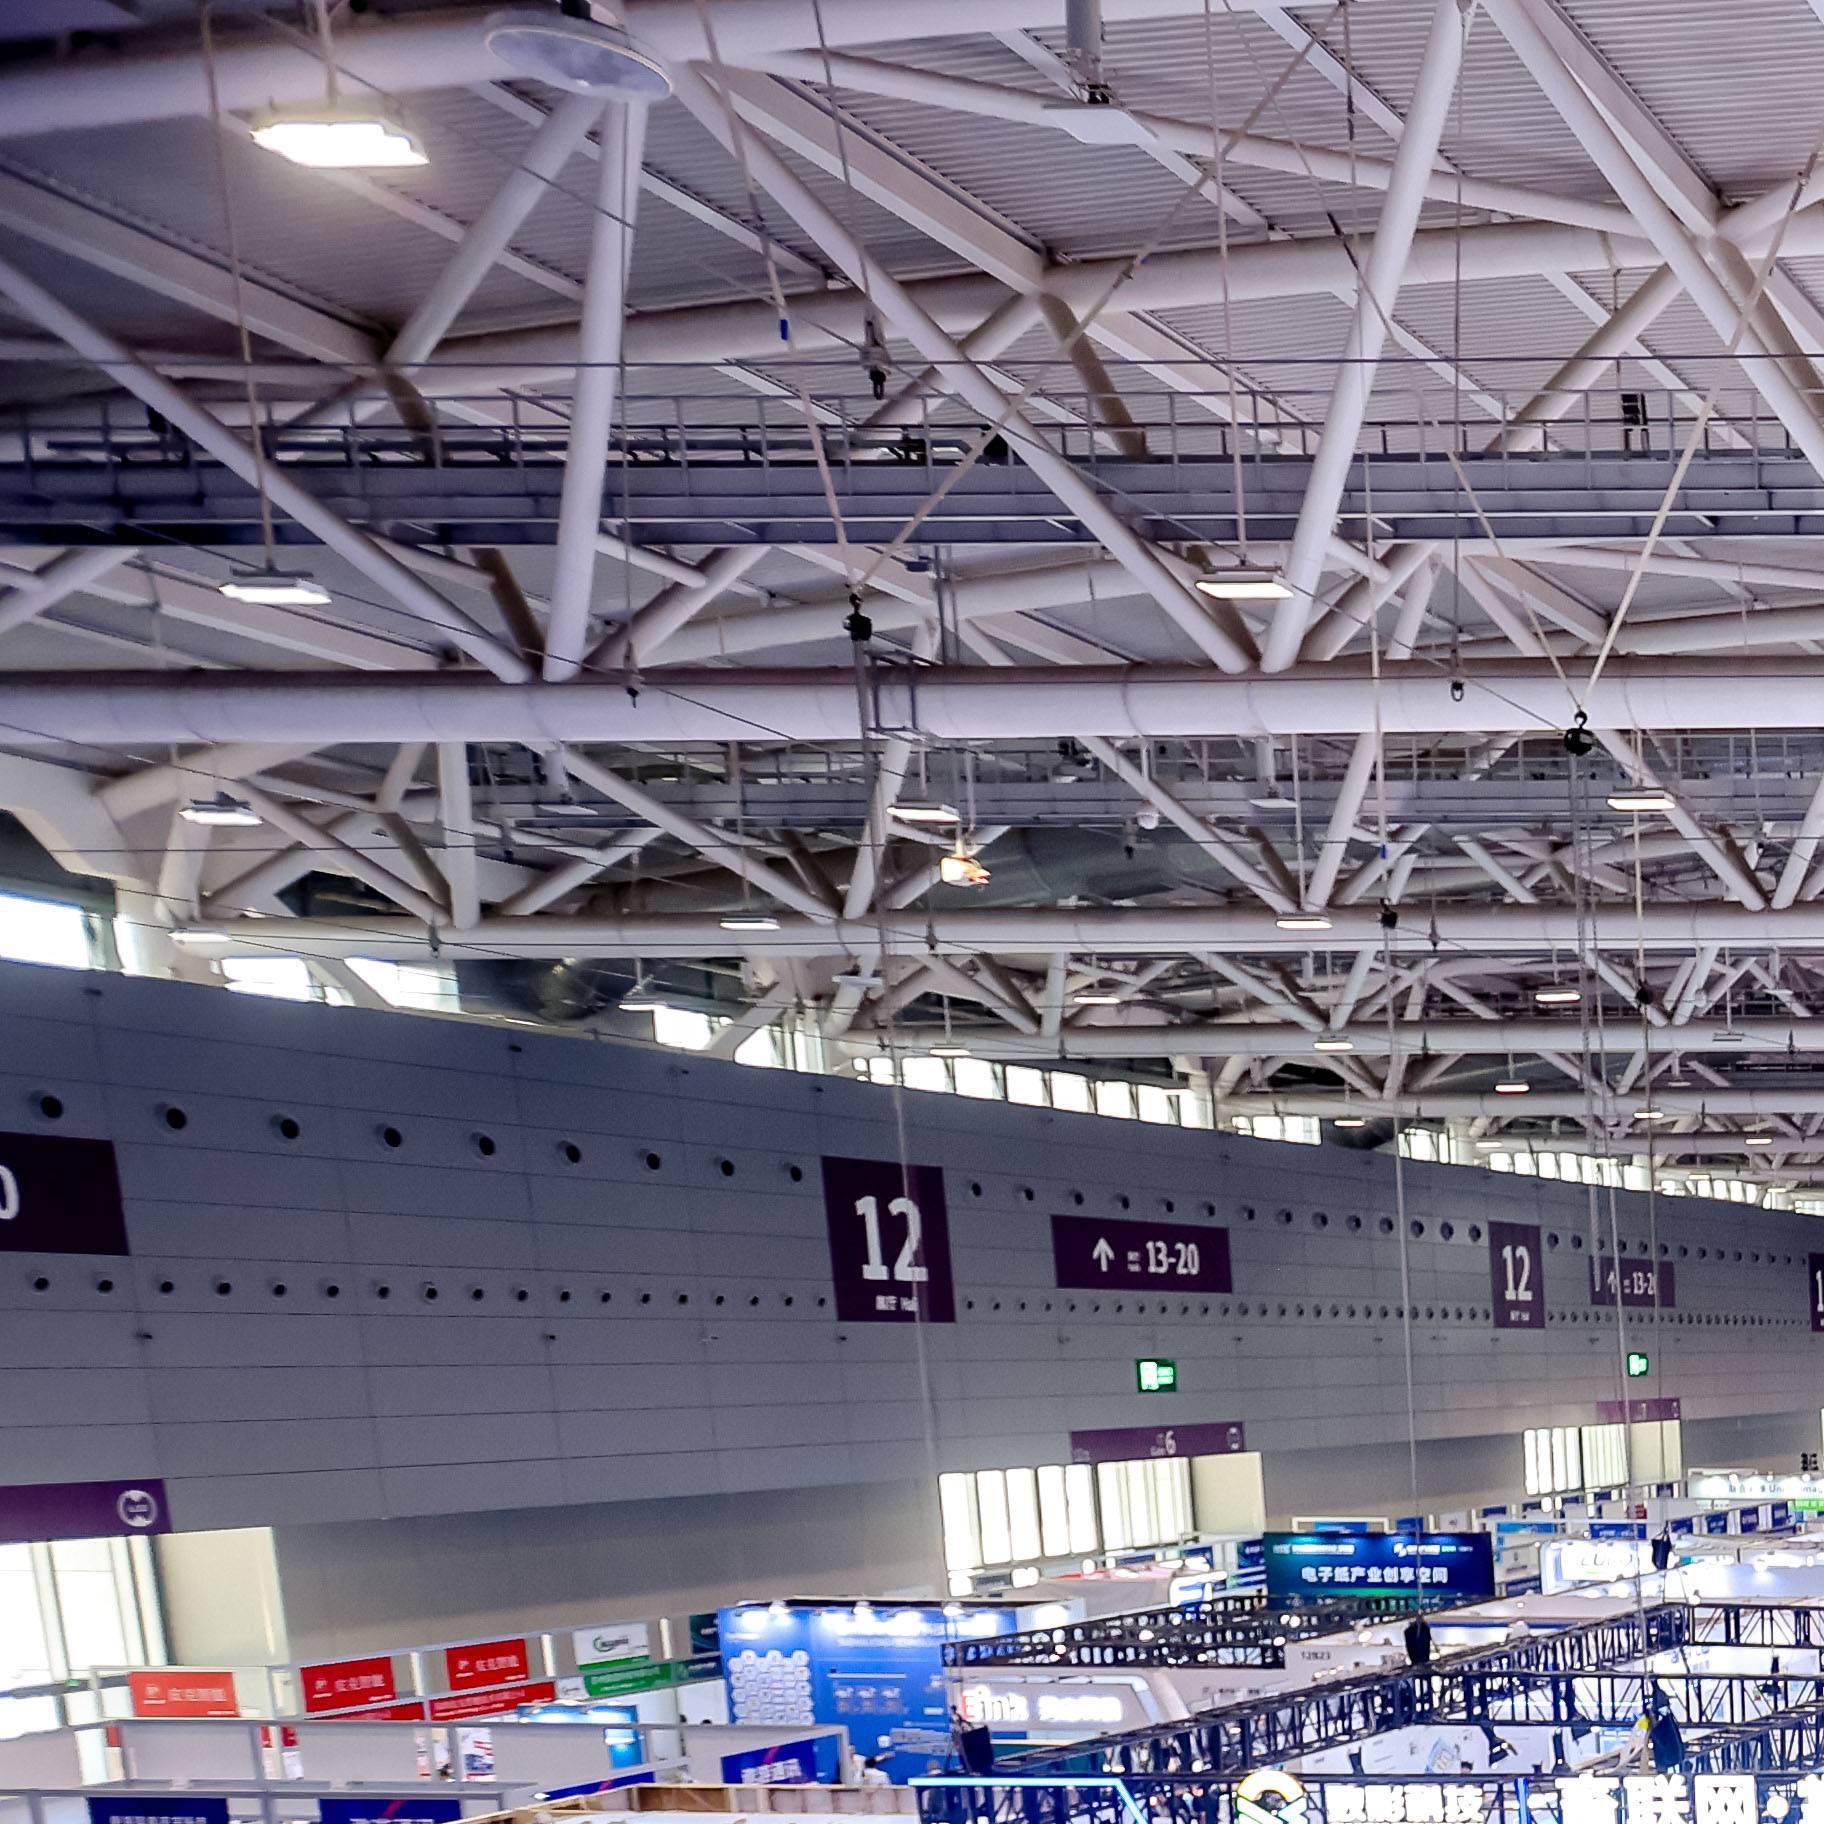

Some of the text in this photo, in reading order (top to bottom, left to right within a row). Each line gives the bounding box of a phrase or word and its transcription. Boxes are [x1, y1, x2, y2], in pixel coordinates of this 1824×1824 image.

[856, 1196, 928, 1281] 12
[1146, 1241, 1200, 1275] 13-20
[1502, 1245, 1532, 1301] 12
[1302, 1566, 1449, 1584] 电子纸产业创享空间
